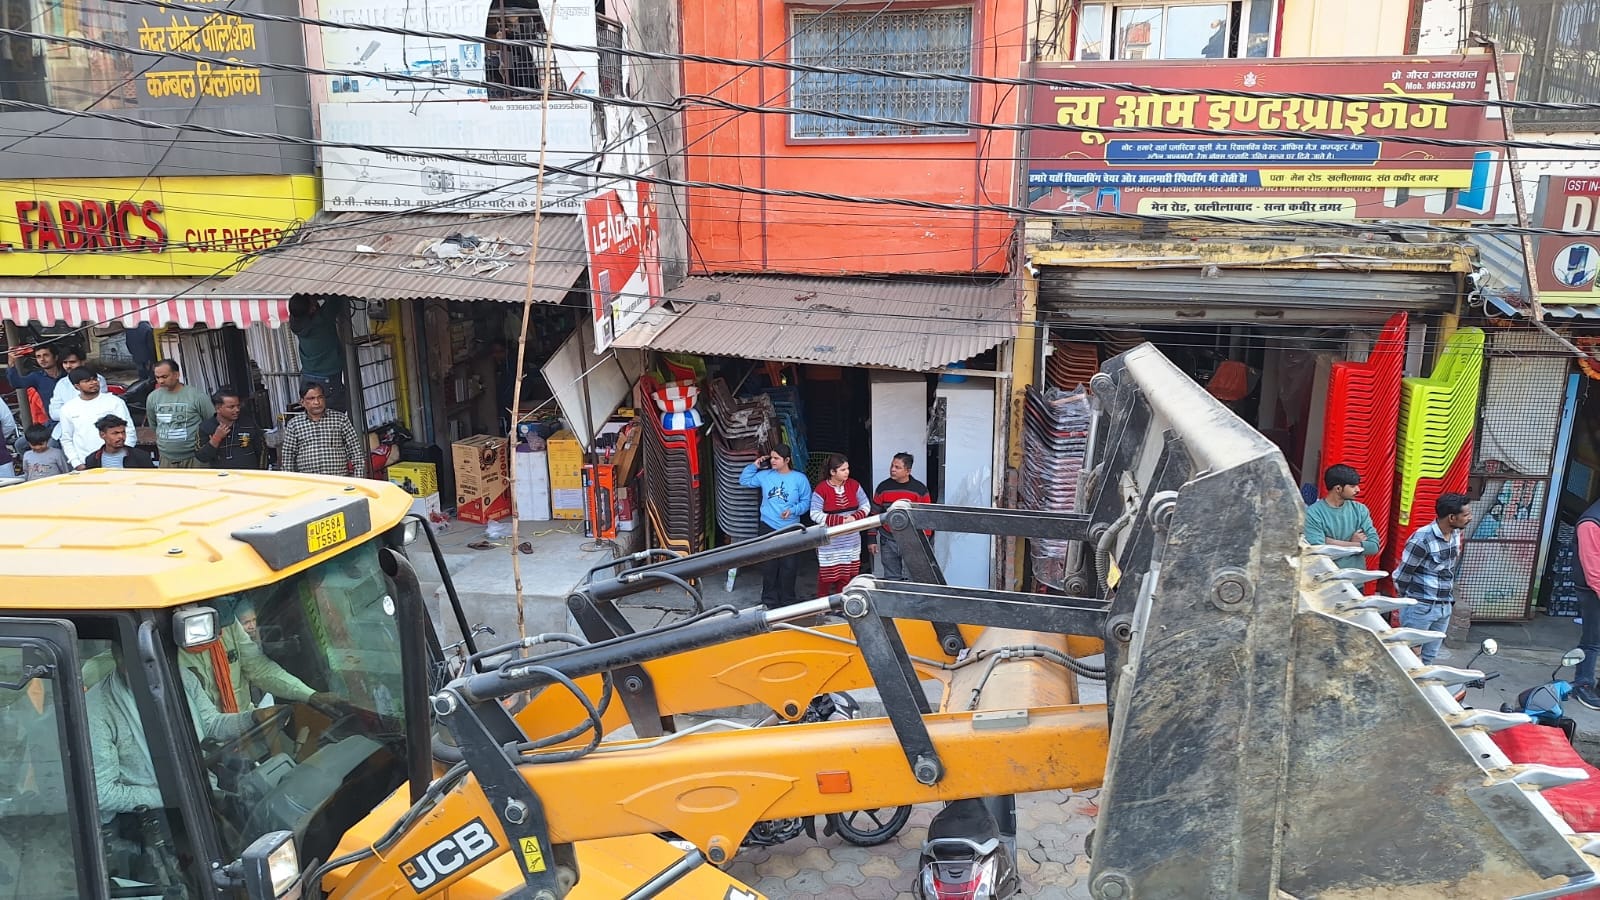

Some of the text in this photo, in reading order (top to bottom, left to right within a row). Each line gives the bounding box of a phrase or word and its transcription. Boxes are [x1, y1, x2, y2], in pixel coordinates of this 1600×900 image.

[138, 17, 166, 52] लेदर
[166, 14, 201, 53] जैकेट
[1406, 69, 1430, 79] गौरव
[1431, 70, 1479, 79] जायसवाल
[145, 71, 196, 99] कम्बल
[1405, 81, 1476, 90] Mob. 9695343970
[1054, 96, 1106, 144] न्यू
[1029, 172, 1047, 183] हमारे
[1103, 172, 1120, 183] चेयर
[1220, 172, 1238, 183] होती
[1308, 173, 1321, 182] रोड
[1393, 172, 1416, 182] कबीर
[1419, 174, 1439, 182] नगर
[1567, 180, 1588, 191] GST
[1151, 201, 1168, 211] मेन
[1194, 201, 1253, 211] खलीलाबाद
[1263, 202, 1286, 211] सन्त
[1287, 201, 1317, 211] कबीर
[1319, 203, 1343, 211] नगर
[15, 200, 168, 253] FABRICS
[315, 516, 341, 536] UP58A
[317, 529, 343, 548] T5581
[411, 822, 494, 889] JCB
